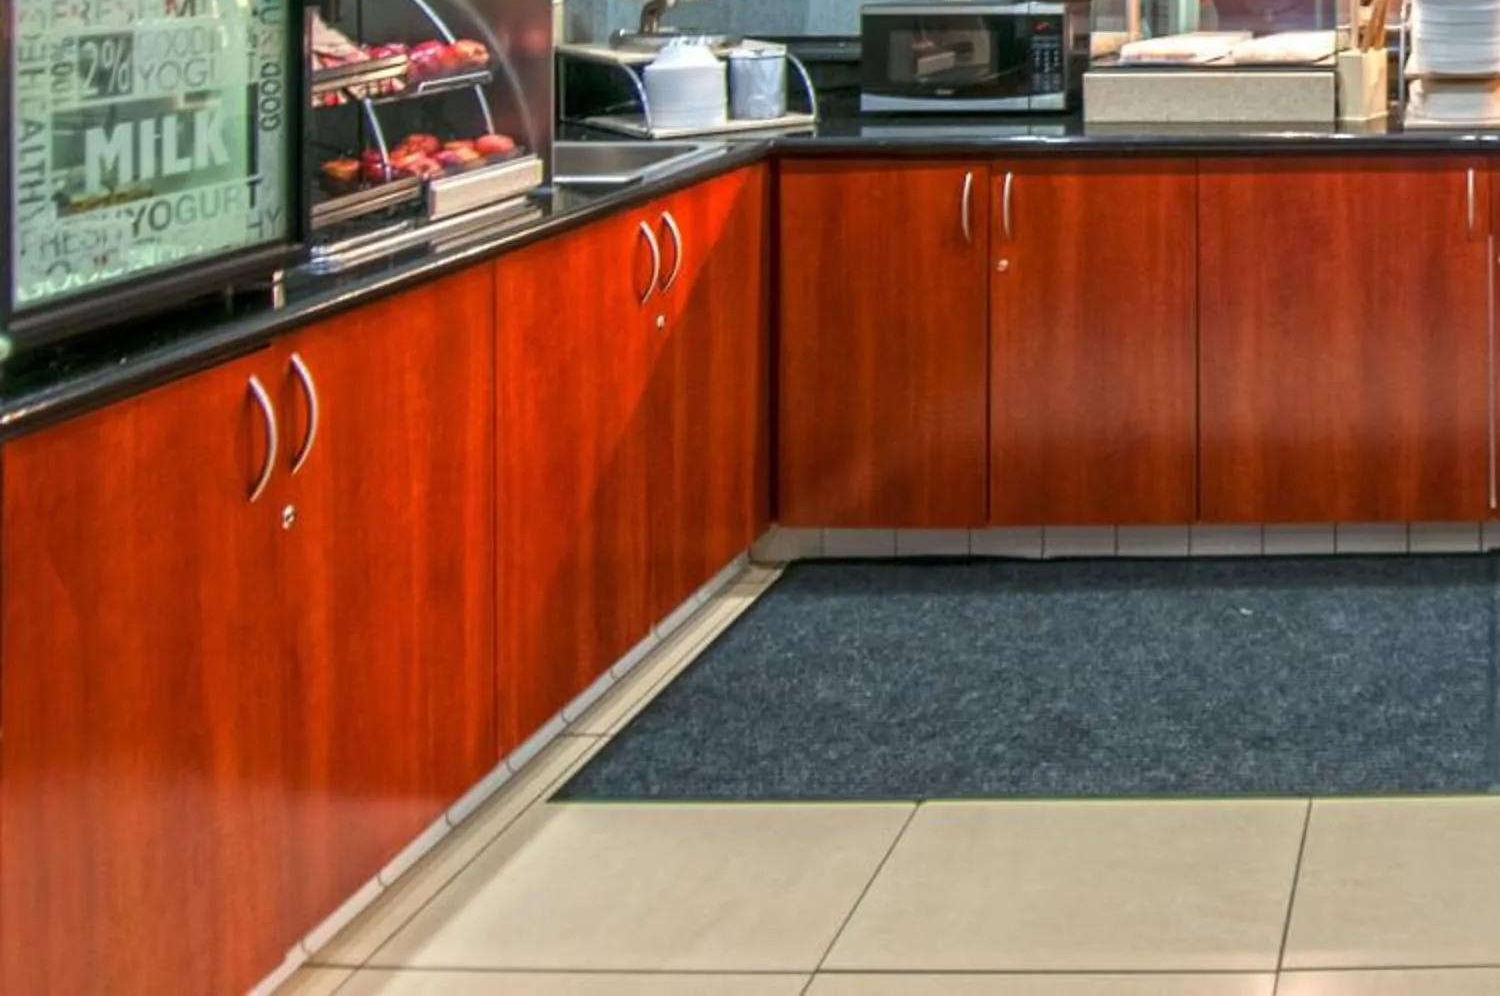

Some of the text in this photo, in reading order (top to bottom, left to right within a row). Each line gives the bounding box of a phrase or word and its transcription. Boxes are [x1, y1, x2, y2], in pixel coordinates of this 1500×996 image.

[82, 39, 131, 96] 2%
[260, 61, 282, 132] GOOD
[84, 98, 231, 198] MILK
